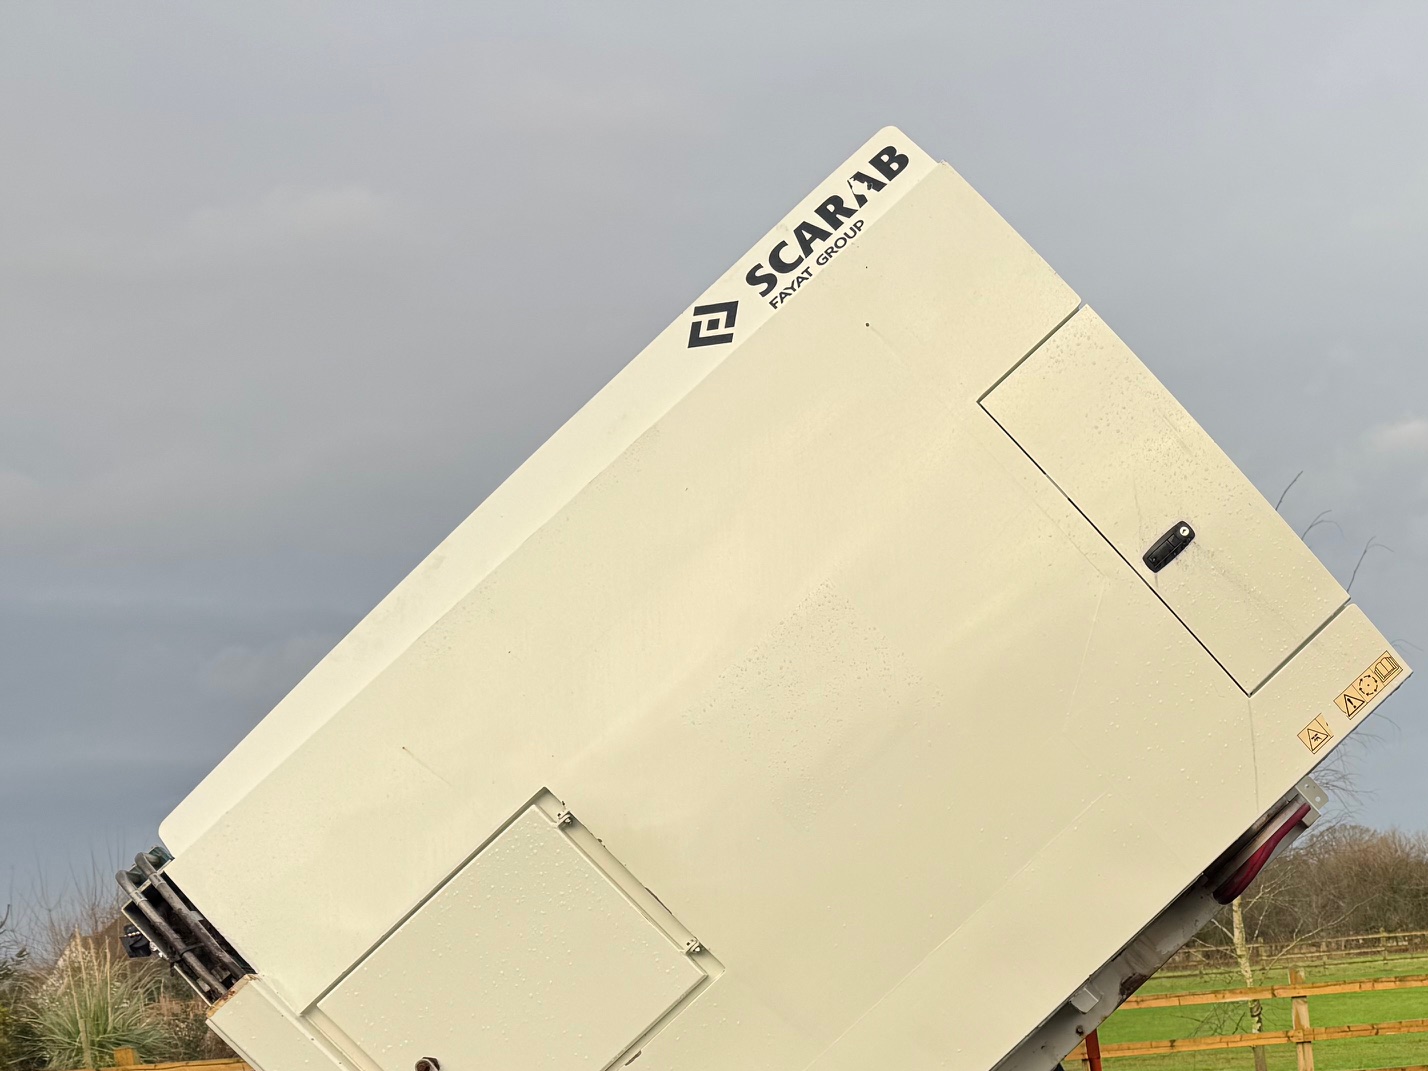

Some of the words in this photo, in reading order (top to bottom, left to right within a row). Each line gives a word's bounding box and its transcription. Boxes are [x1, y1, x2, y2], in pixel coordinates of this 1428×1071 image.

[745, 145, 910, 297] SCARAB
[768, 266, 814, 310] FAYAT
[815, 219, 865, 266] GROUP
